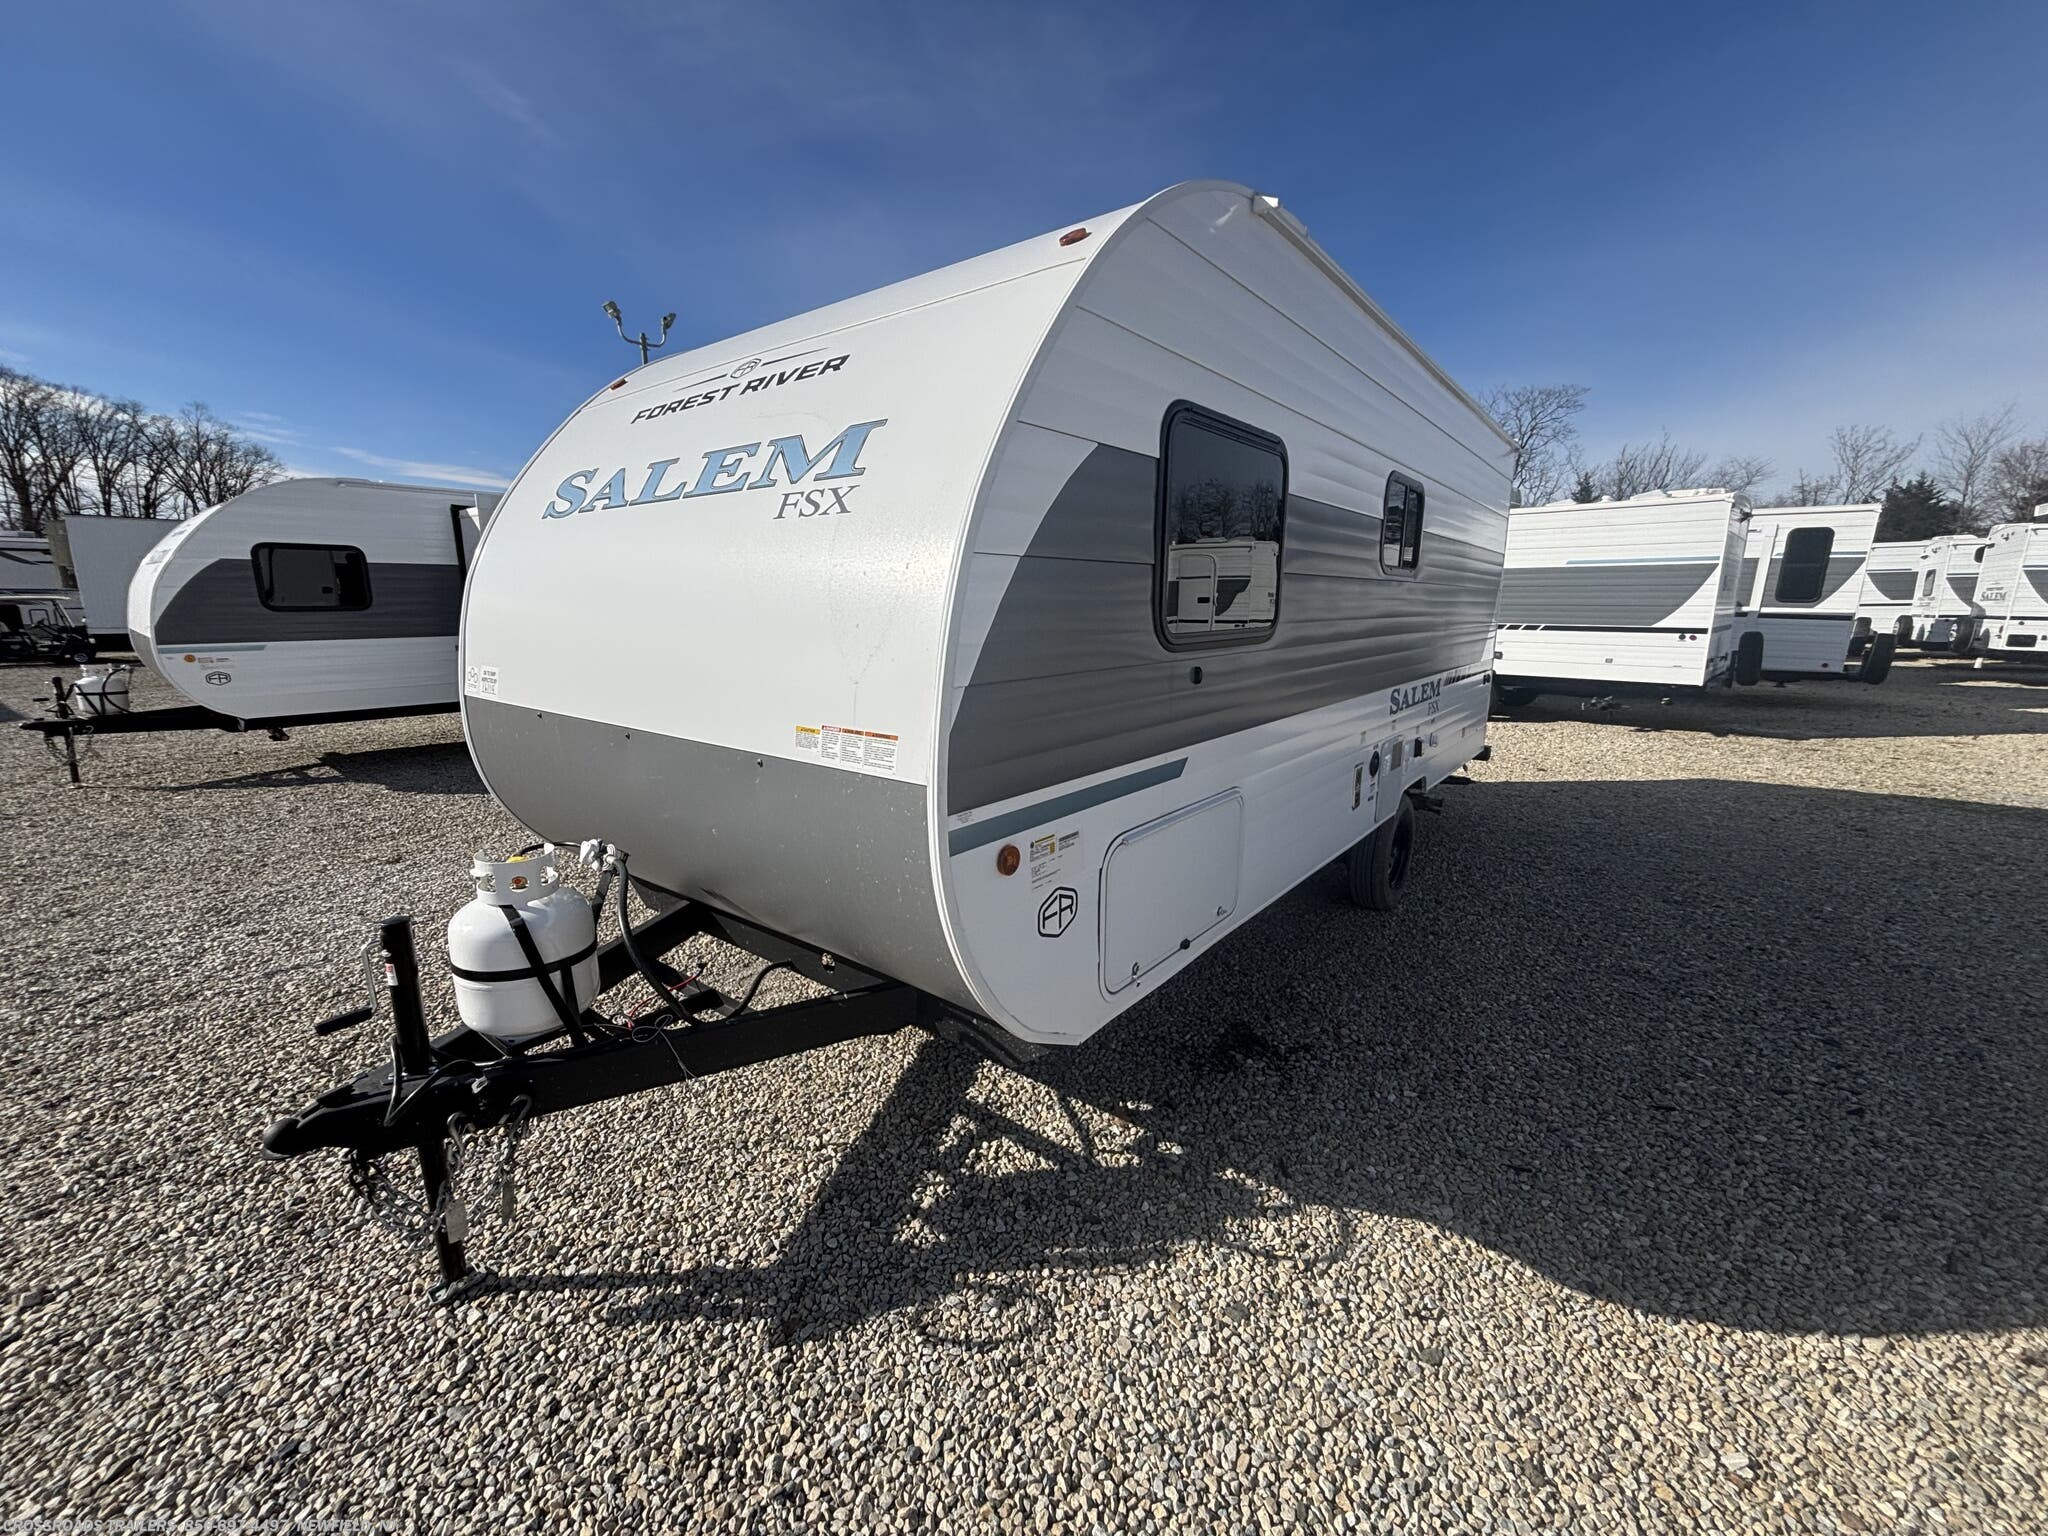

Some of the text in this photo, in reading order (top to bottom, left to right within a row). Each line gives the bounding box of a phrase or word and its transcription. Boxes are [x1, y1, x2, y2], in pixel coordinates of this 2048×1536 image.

[631, 354, 851, 424] FOREST RIVER
[541, 418, 888, 519] SALEM
[773, 485, 860, 519] FSX
[1389, 678, 1442, 715] SALEM
